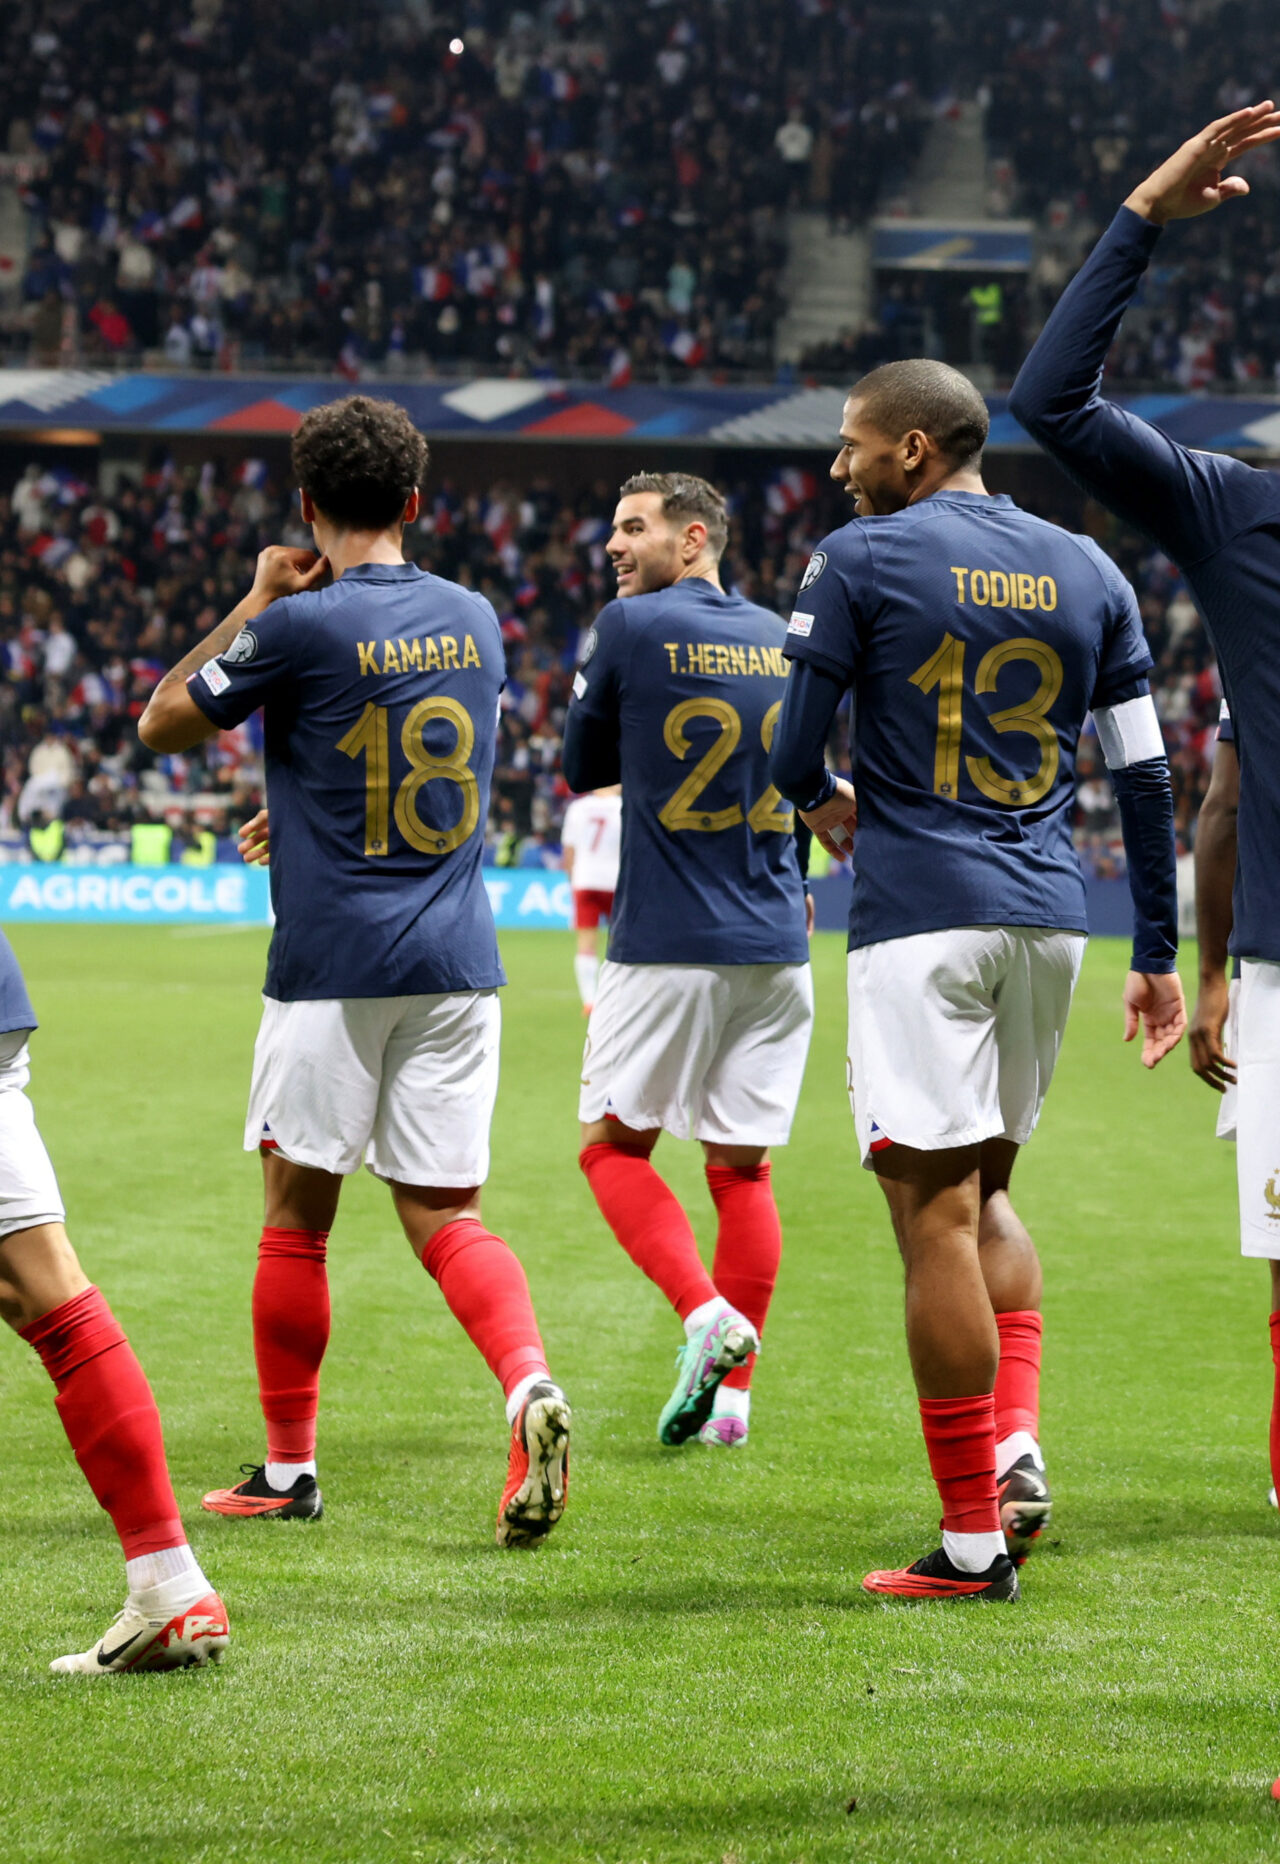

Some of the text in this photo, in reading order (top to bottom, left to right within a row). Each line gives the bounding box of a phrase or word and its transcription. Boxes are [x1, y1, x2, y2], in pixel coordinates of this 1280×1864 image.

[950, 566, 1058, 612] TODIBO
[357, 634, 482, 676] KAMARA
[908, 632, 1064, 806] 13
[335, 696, 480, 857] 18
[589, 816, 607, 853] 7
[9, 873, 246, 913] AGRICOLE
